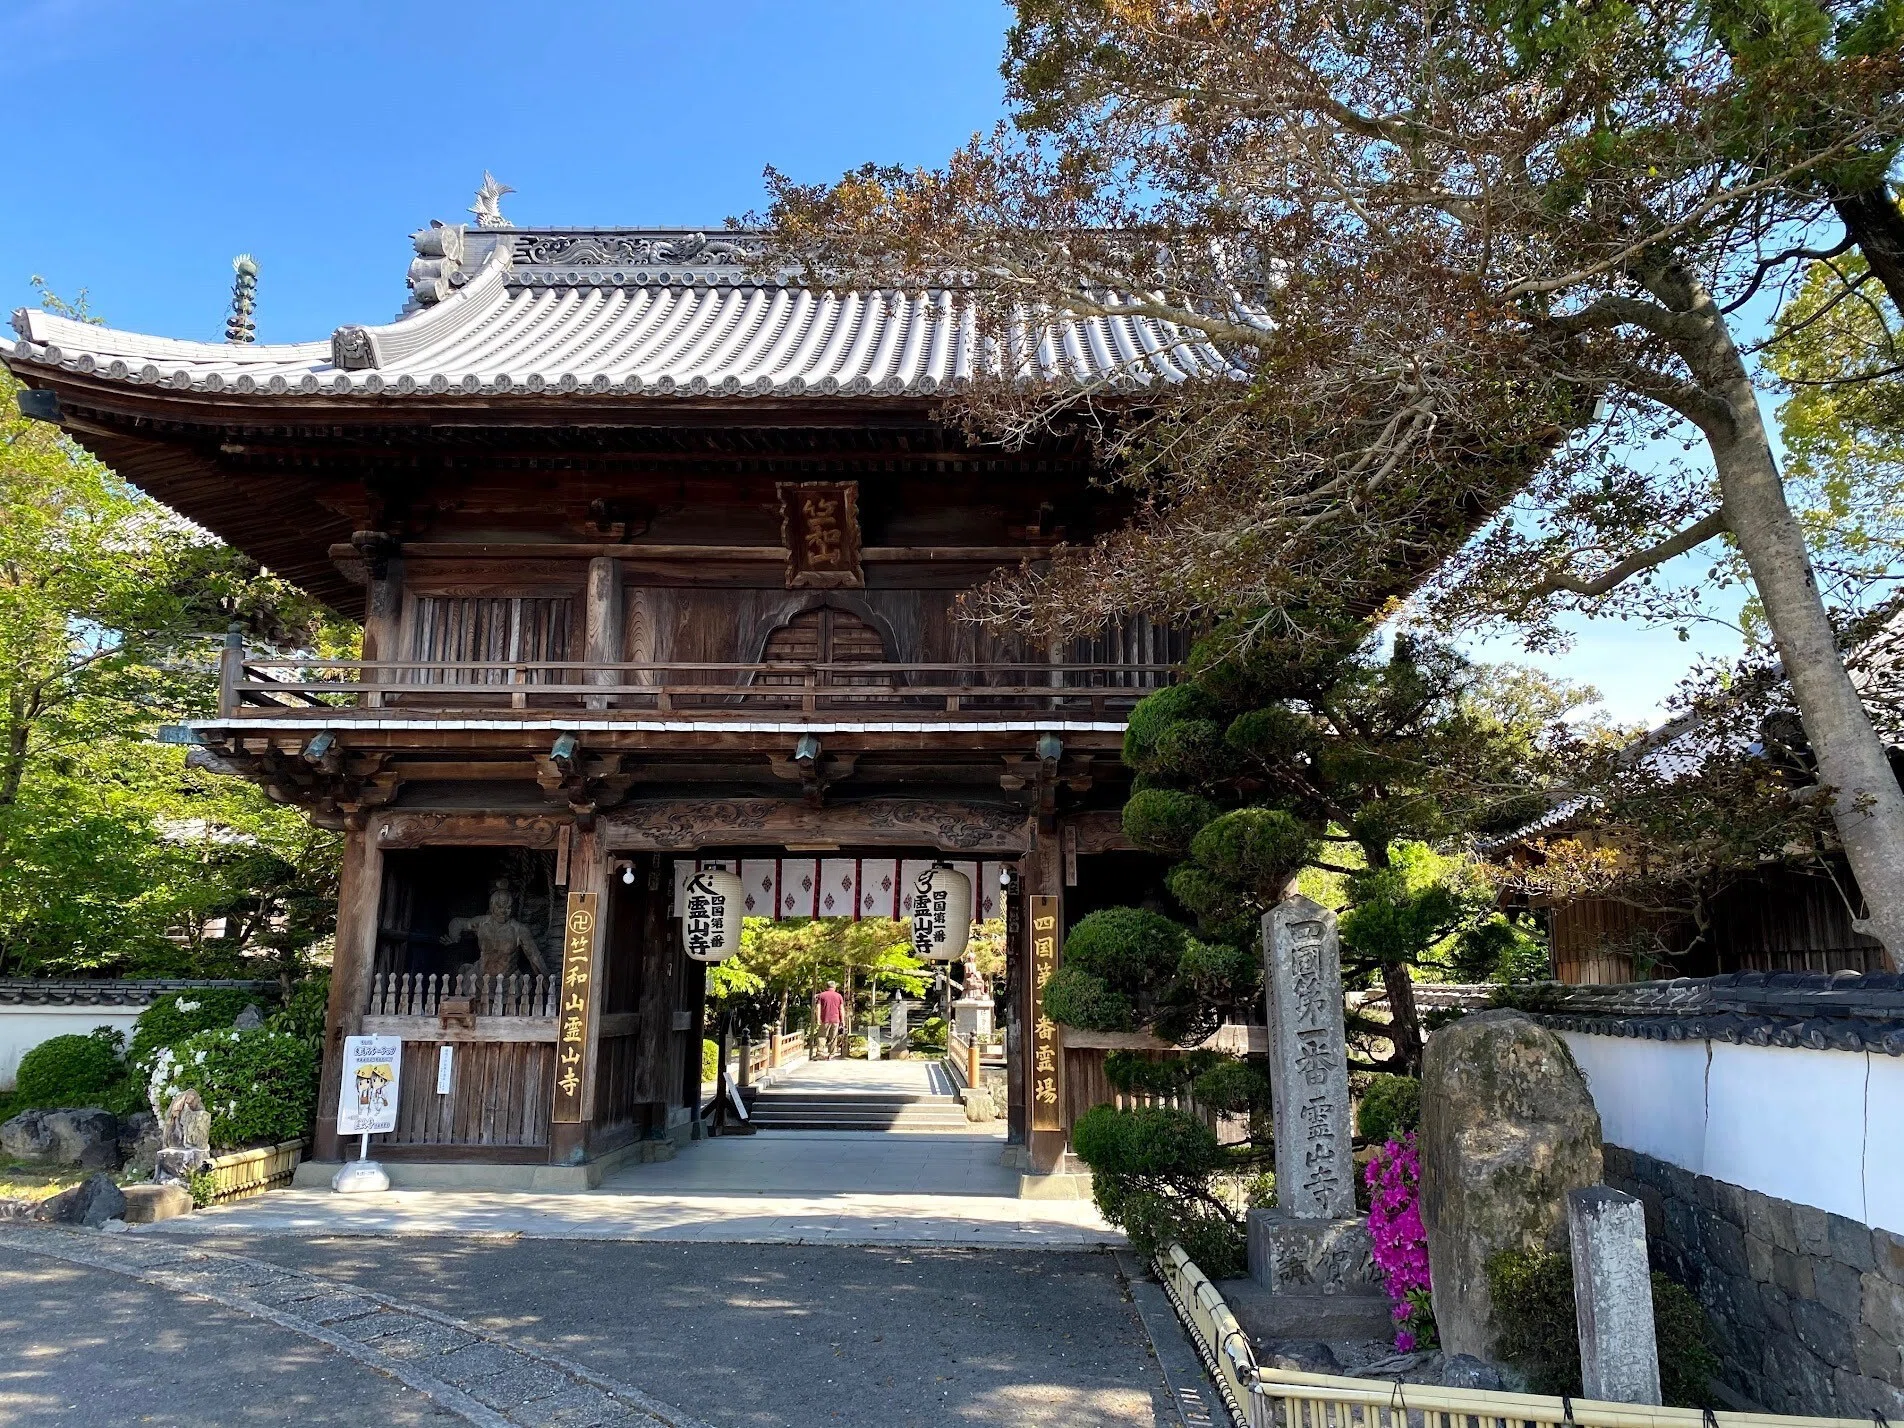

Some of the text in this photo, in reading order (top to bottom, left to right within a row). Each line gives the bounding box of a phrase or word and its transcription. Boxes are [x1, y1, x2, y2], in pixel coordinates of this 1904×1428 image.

[710, 895, 726, 948] 四国第一番
[933, 890, 948, 943] 四国第一番
